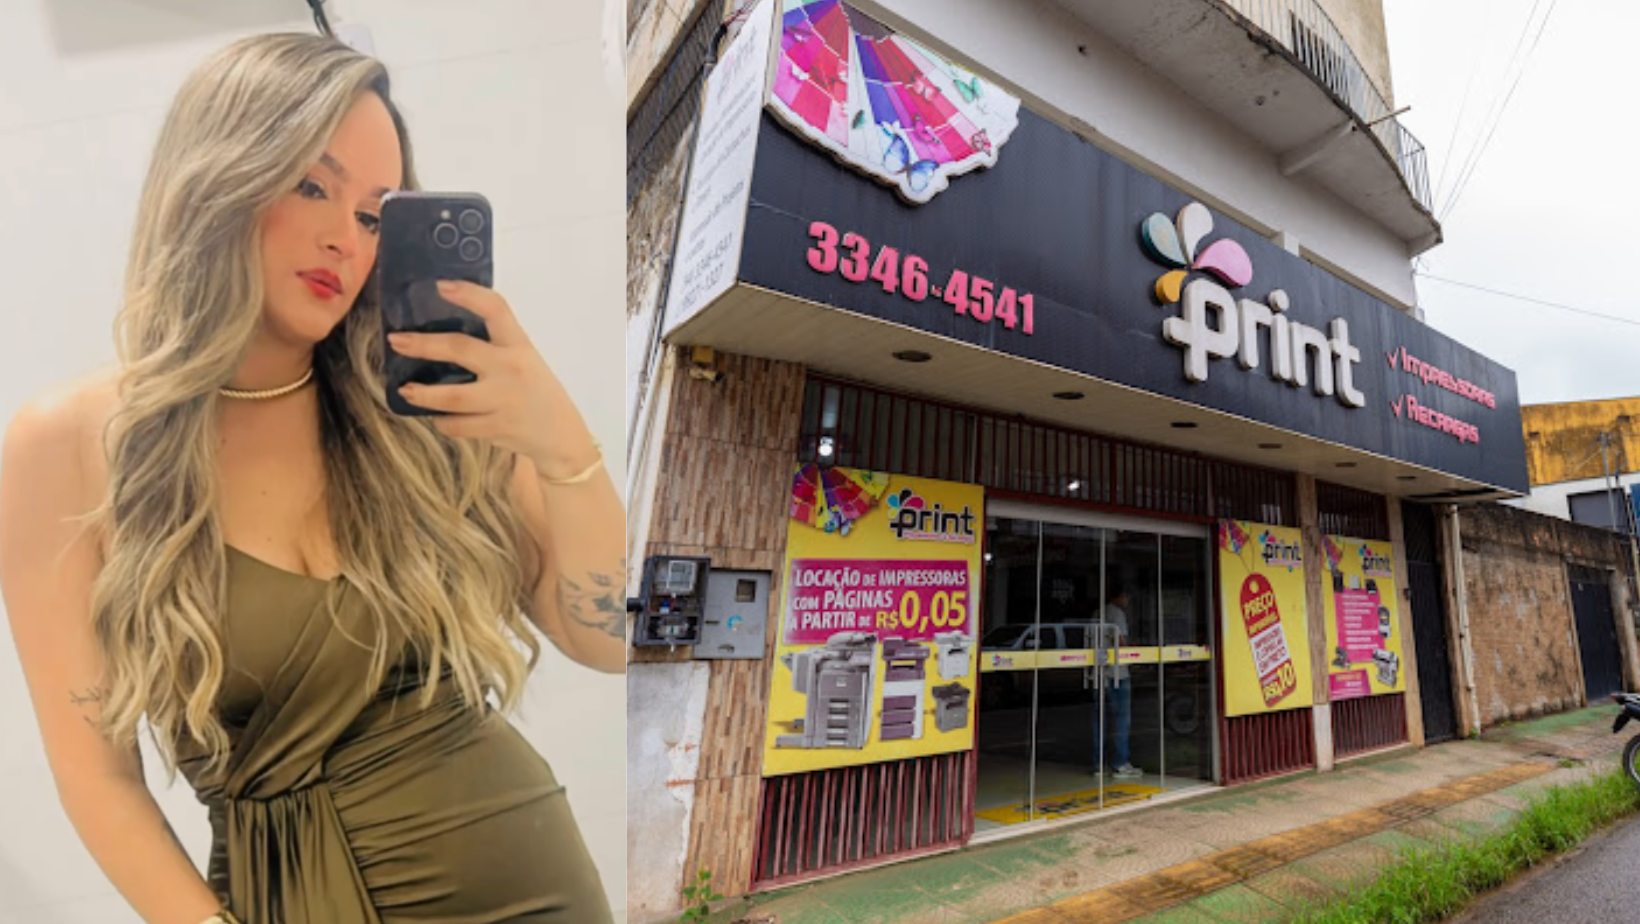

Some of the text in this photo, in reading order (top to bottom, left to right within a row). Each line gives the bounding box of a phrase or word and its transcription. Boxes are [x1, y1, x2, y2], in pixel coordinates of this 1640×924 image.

[807, 221, 1034, 335] 3346-4541
[1163, 277, 1365, 408] print
[889, 503, 975, 538] print
[1261, 538, 1301, 563] print
[795, 567, 966, 589] LOCAÇÃO DE IMPRESSORAS
[793, 585, 893, 611] COM PÁGINAS
[801, 611, 856, 630] PARTIR
